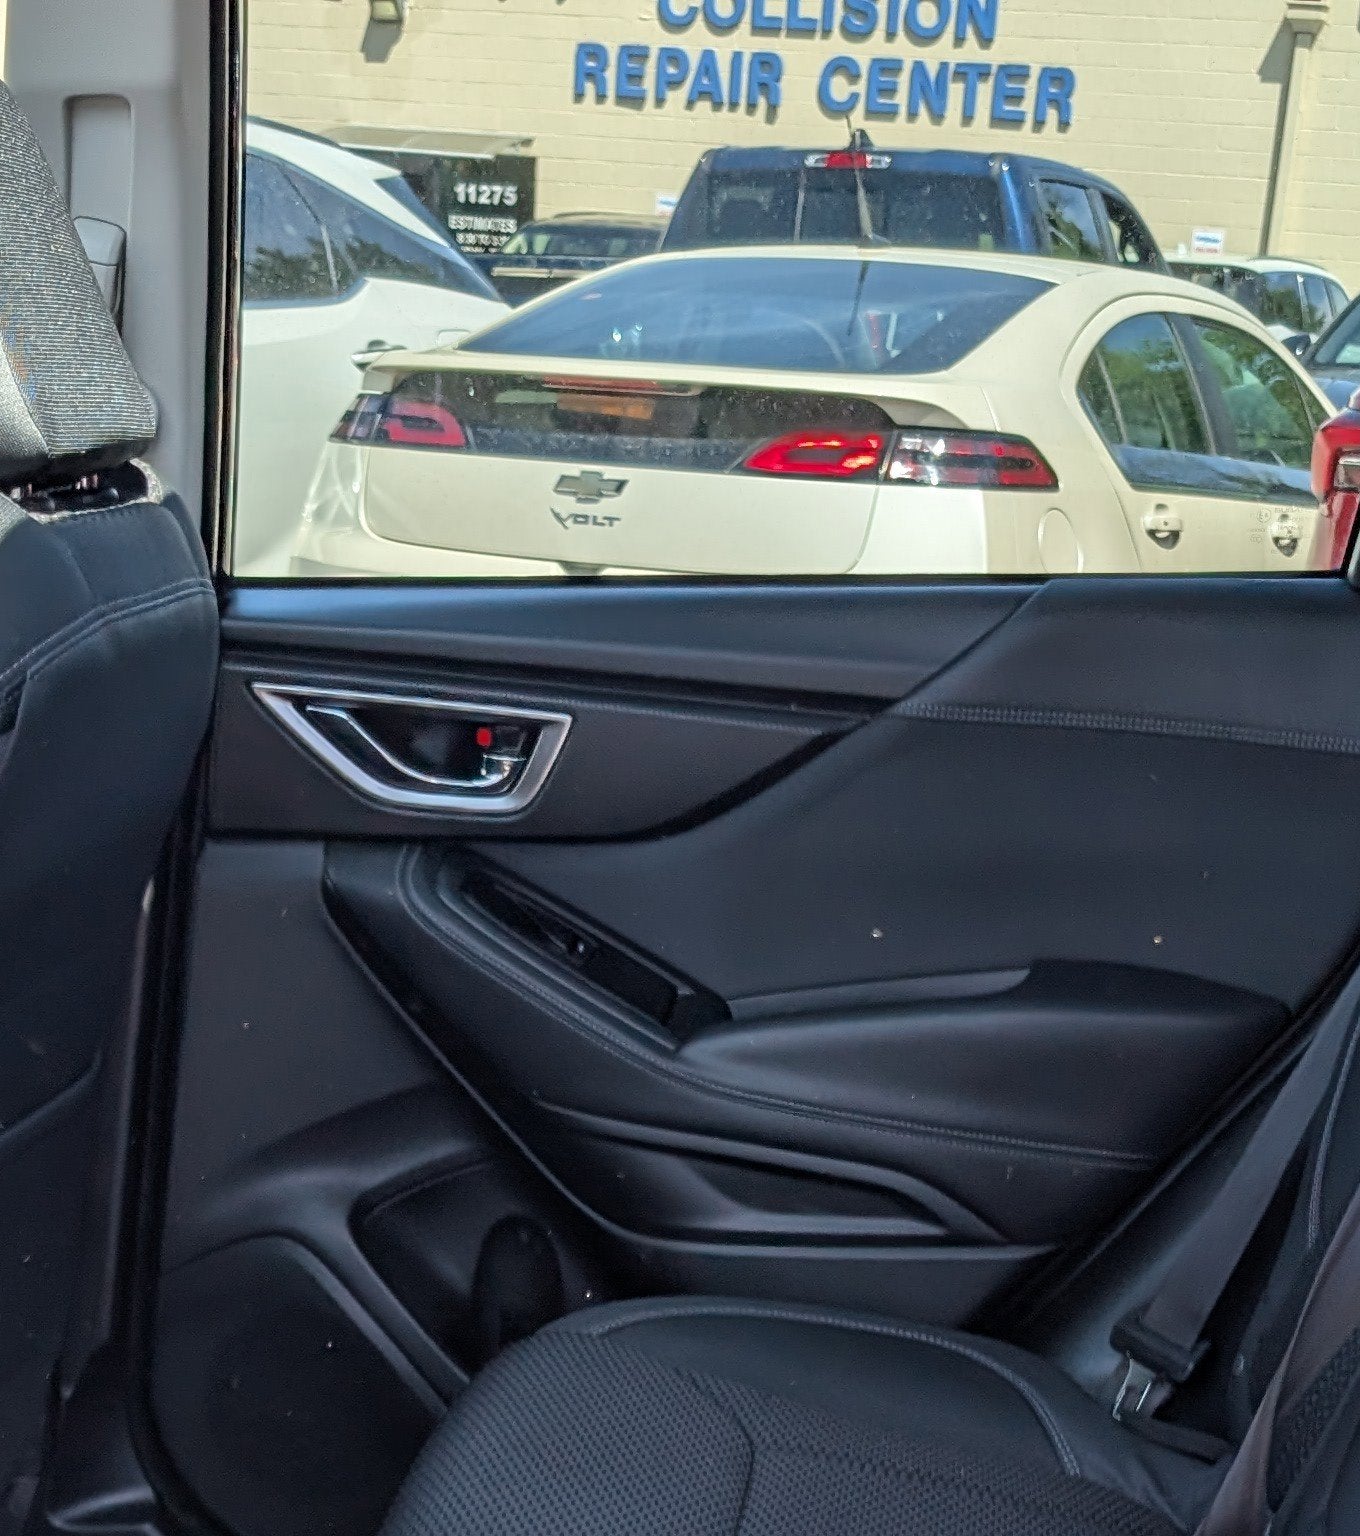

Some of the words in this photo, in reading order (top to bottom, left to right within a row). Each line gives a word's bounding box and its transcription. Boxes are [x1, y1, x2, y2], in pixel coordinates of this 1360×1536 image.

[659, 0, 999, 43] COLLISION
[574, 43, 783, 107] REPAIR
[818, 56, 1075, 126] CENTER
[453, 183, 518, 206] 11275
[550, 507, 622, 530] VOLT
